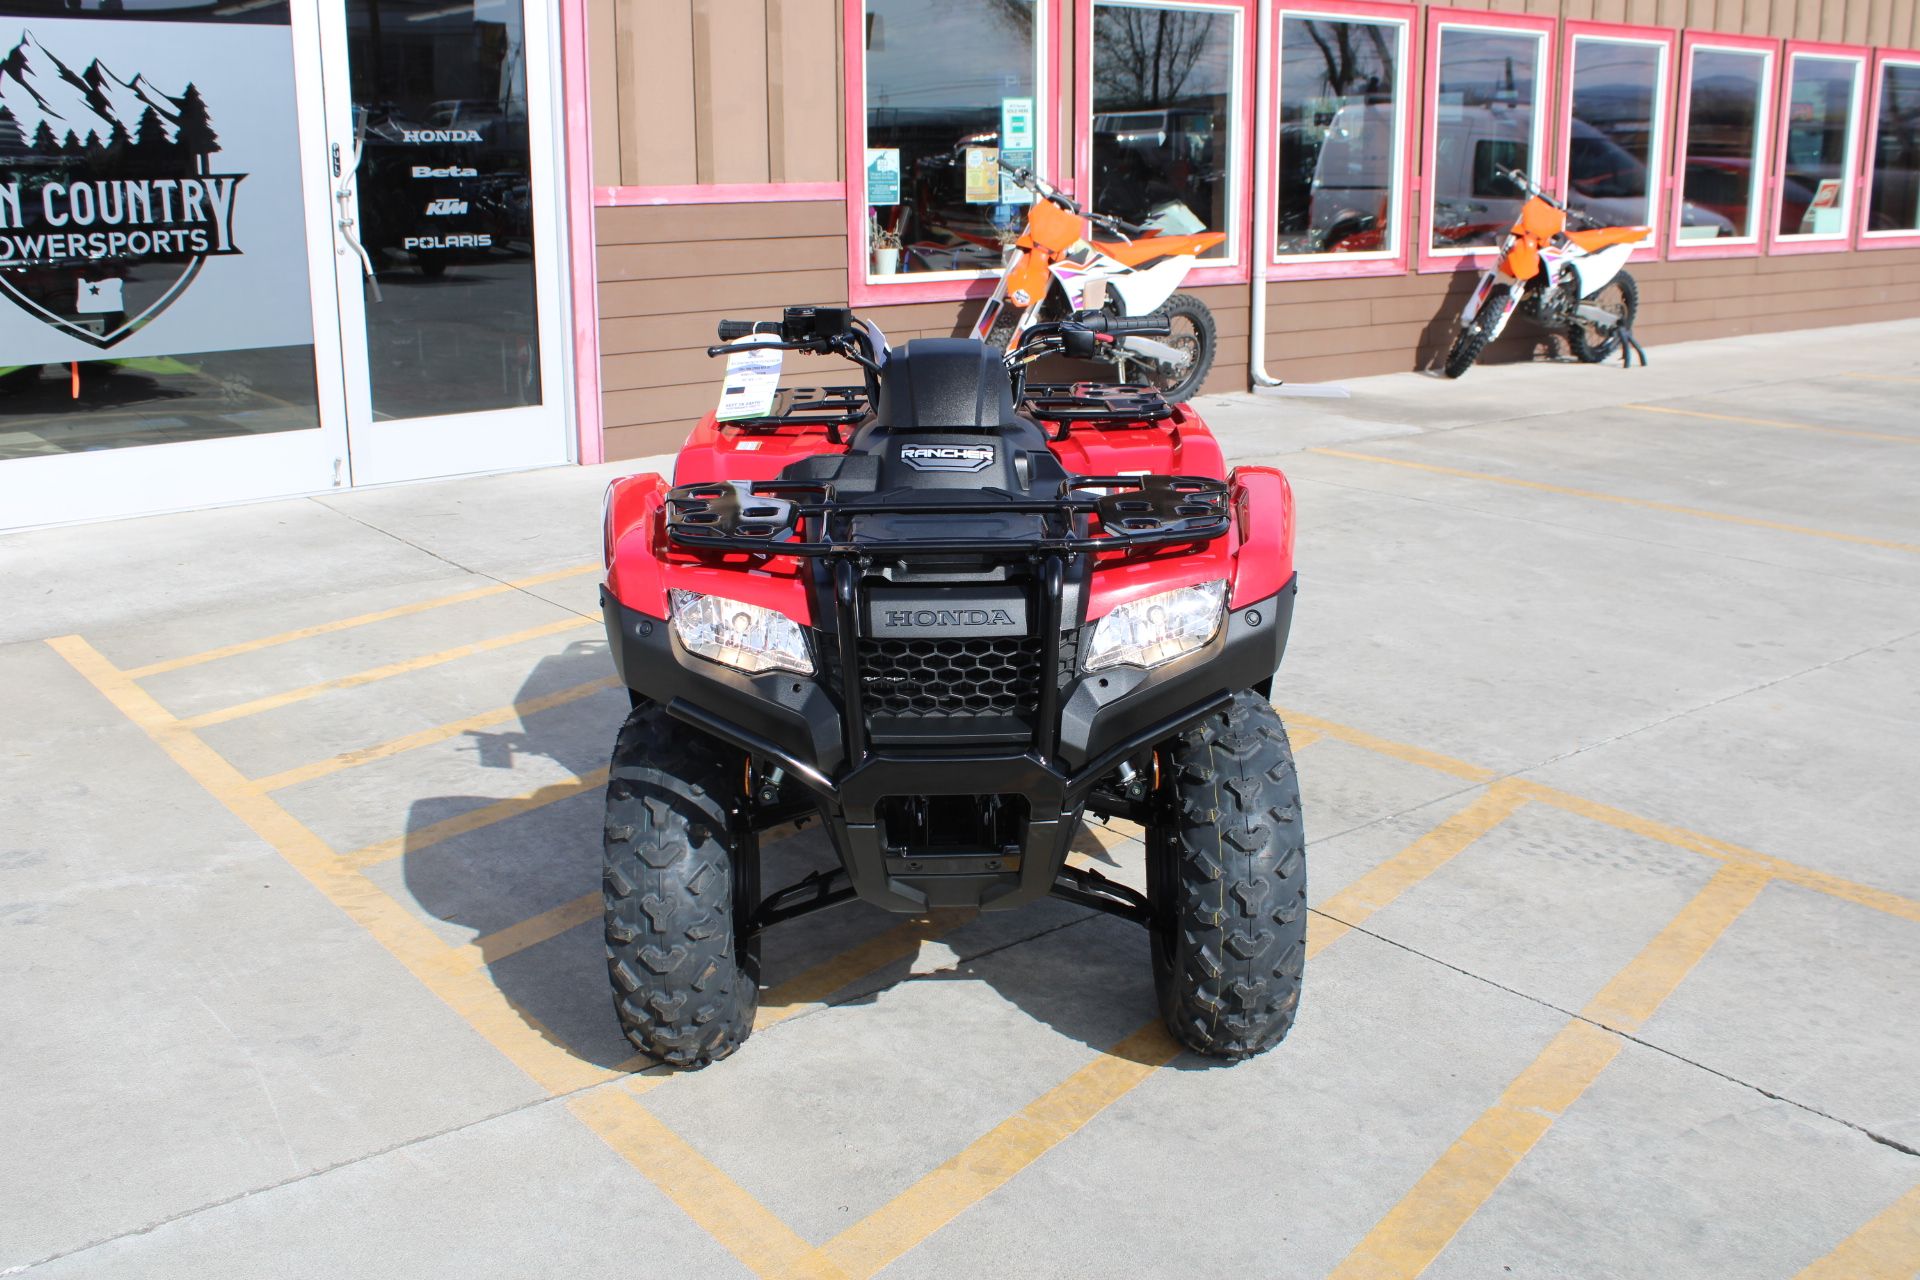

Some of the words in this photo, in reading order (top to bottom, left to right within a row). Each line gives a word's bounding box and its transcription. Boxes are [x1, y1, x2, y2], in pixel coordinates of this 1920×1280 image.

[402, 129, 483, 142] HONDA
[412, 166, 477, 178] Beta
[426, 198, 468, 215] KTM
[43, 178, 236, 251] COUNTRY
[404, 234, 492, 249] POLARIS
[901, 448, 994, 461] RANCHER
[885, 609, 1015, 627] HONDA
